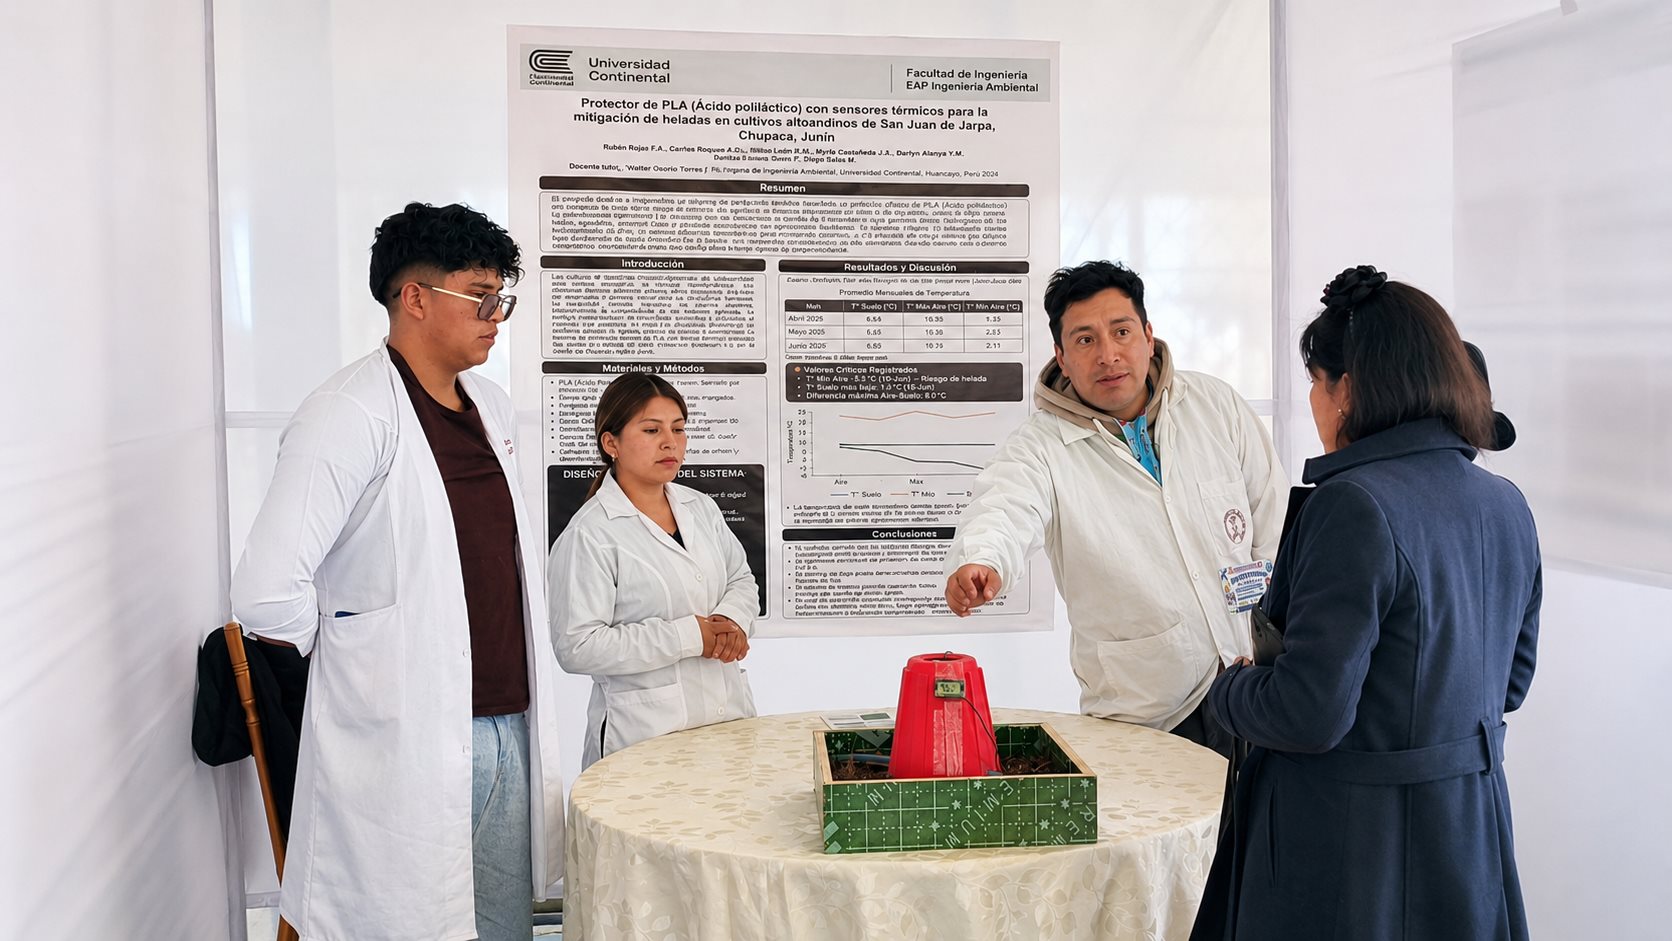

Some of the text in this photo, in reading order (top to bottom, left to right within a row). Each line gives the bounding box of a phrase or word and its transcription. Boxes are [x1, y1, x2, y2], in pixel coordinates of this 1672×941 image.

[589, 58, 669, 69] Universidad
[589, 71, 669, 83] Continental
[907, 69, 954, 78] Facultad
[958, 70, 971, 78] de
[907, 81, 928, 89] EAP
[986, 83, 1038, 91] Ambiental
[582, 98, 639, 109] Protector
[643, 100, 657, 109] de
[663, 100, 687, 110] PLA
[692, 99, 731, 112] (Ácido
[735, 102, 801, 115] poliláctico)
[833, 107, 887, 115] sensores
[892, 106, 944, 116] térmicos
[948, 109, 973, 118] para
[978, 107, 987, 116] la
[574, 112, 639, 124] mitigación
[644, 114, 658, 123] de
[663, 115, 711, 125] heladas
[734, 116, 782, 126] cultivos
[786, 117, 857, 128] altoandinos
[862, 119, 876, 128] de
[881, 119, 903, 128] San
[907, 120, 936, 129] Juan
[940, 121, 955, 130] de
[959, 121, 995, 132] Jarpa,
[739, 130, 796, 143] Chupaca,
[760, 183, 806, 193] Resumen
[621, 259, 684, 270] Introducción
[845, 263, 898, 271] Resultados
[909, 263, 956, 271] Discusión
[603, 364, 704, 374] Materiales y Métodos
[872, 530, 937, 538] Conclusiones
